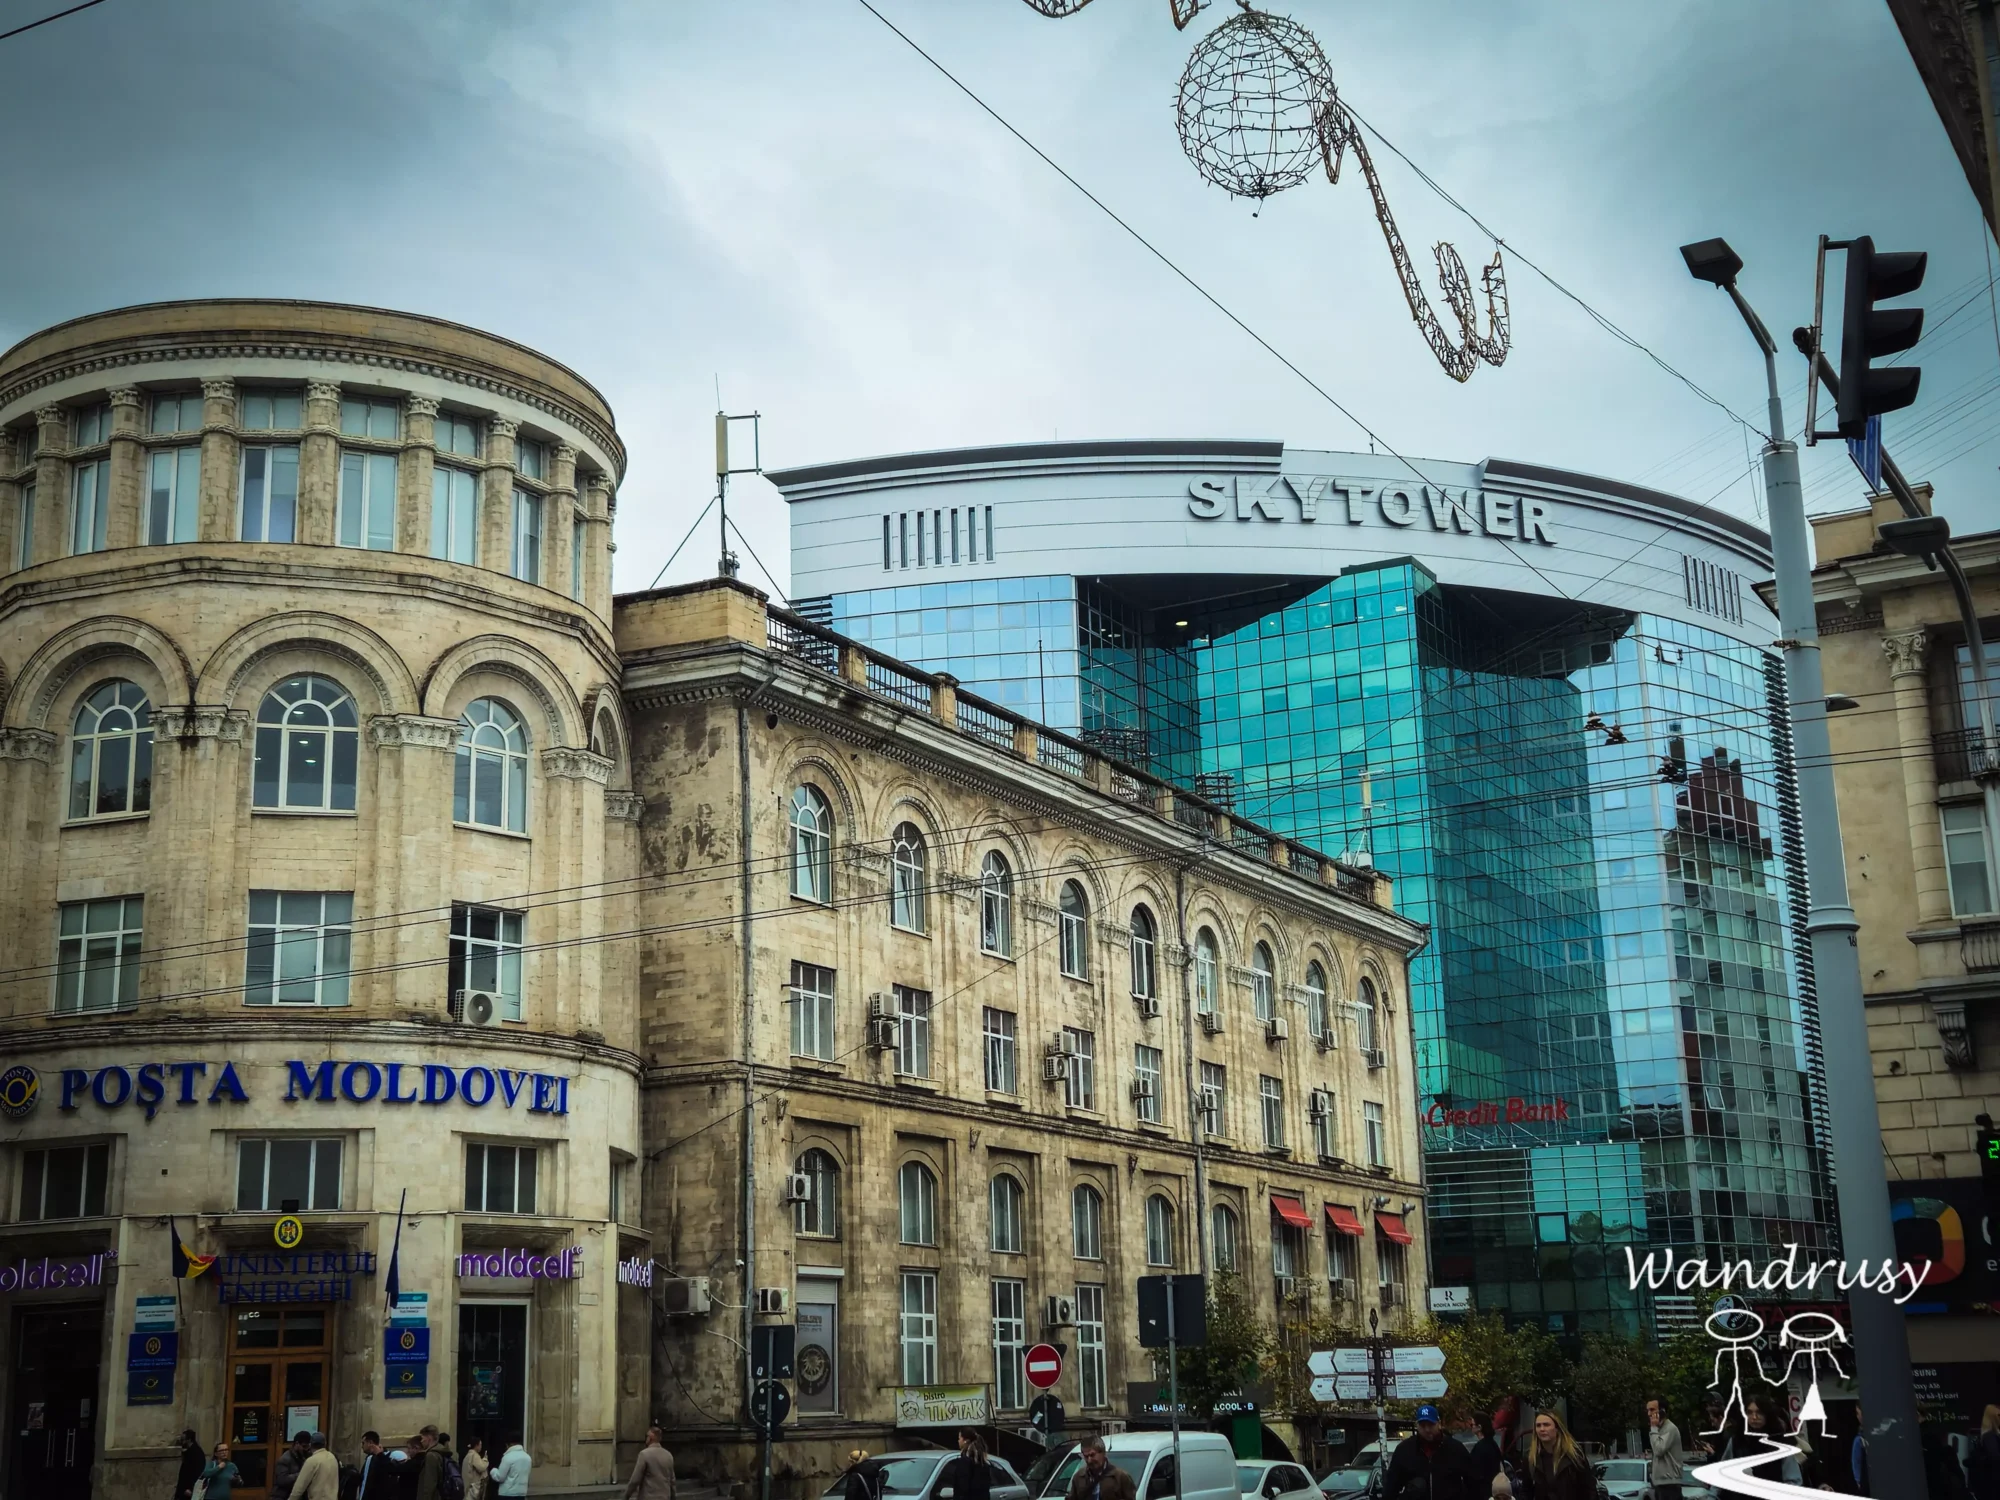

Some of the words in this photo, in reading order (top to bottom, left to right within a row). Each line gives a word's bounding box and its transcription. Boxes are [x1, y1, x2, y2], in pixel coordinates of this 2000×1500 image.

[1188, 474, 1558, 544] SKYTOWER
[59, 1061, 249, 1121] POȘTA
[284, 1060, 570, 1115] MOLDOVEI
[1505, 1096, 1570, 1123] Bank
[459, 1247, 574, 1278] moldcell
[924, 1392, 945, 1401] bistro
